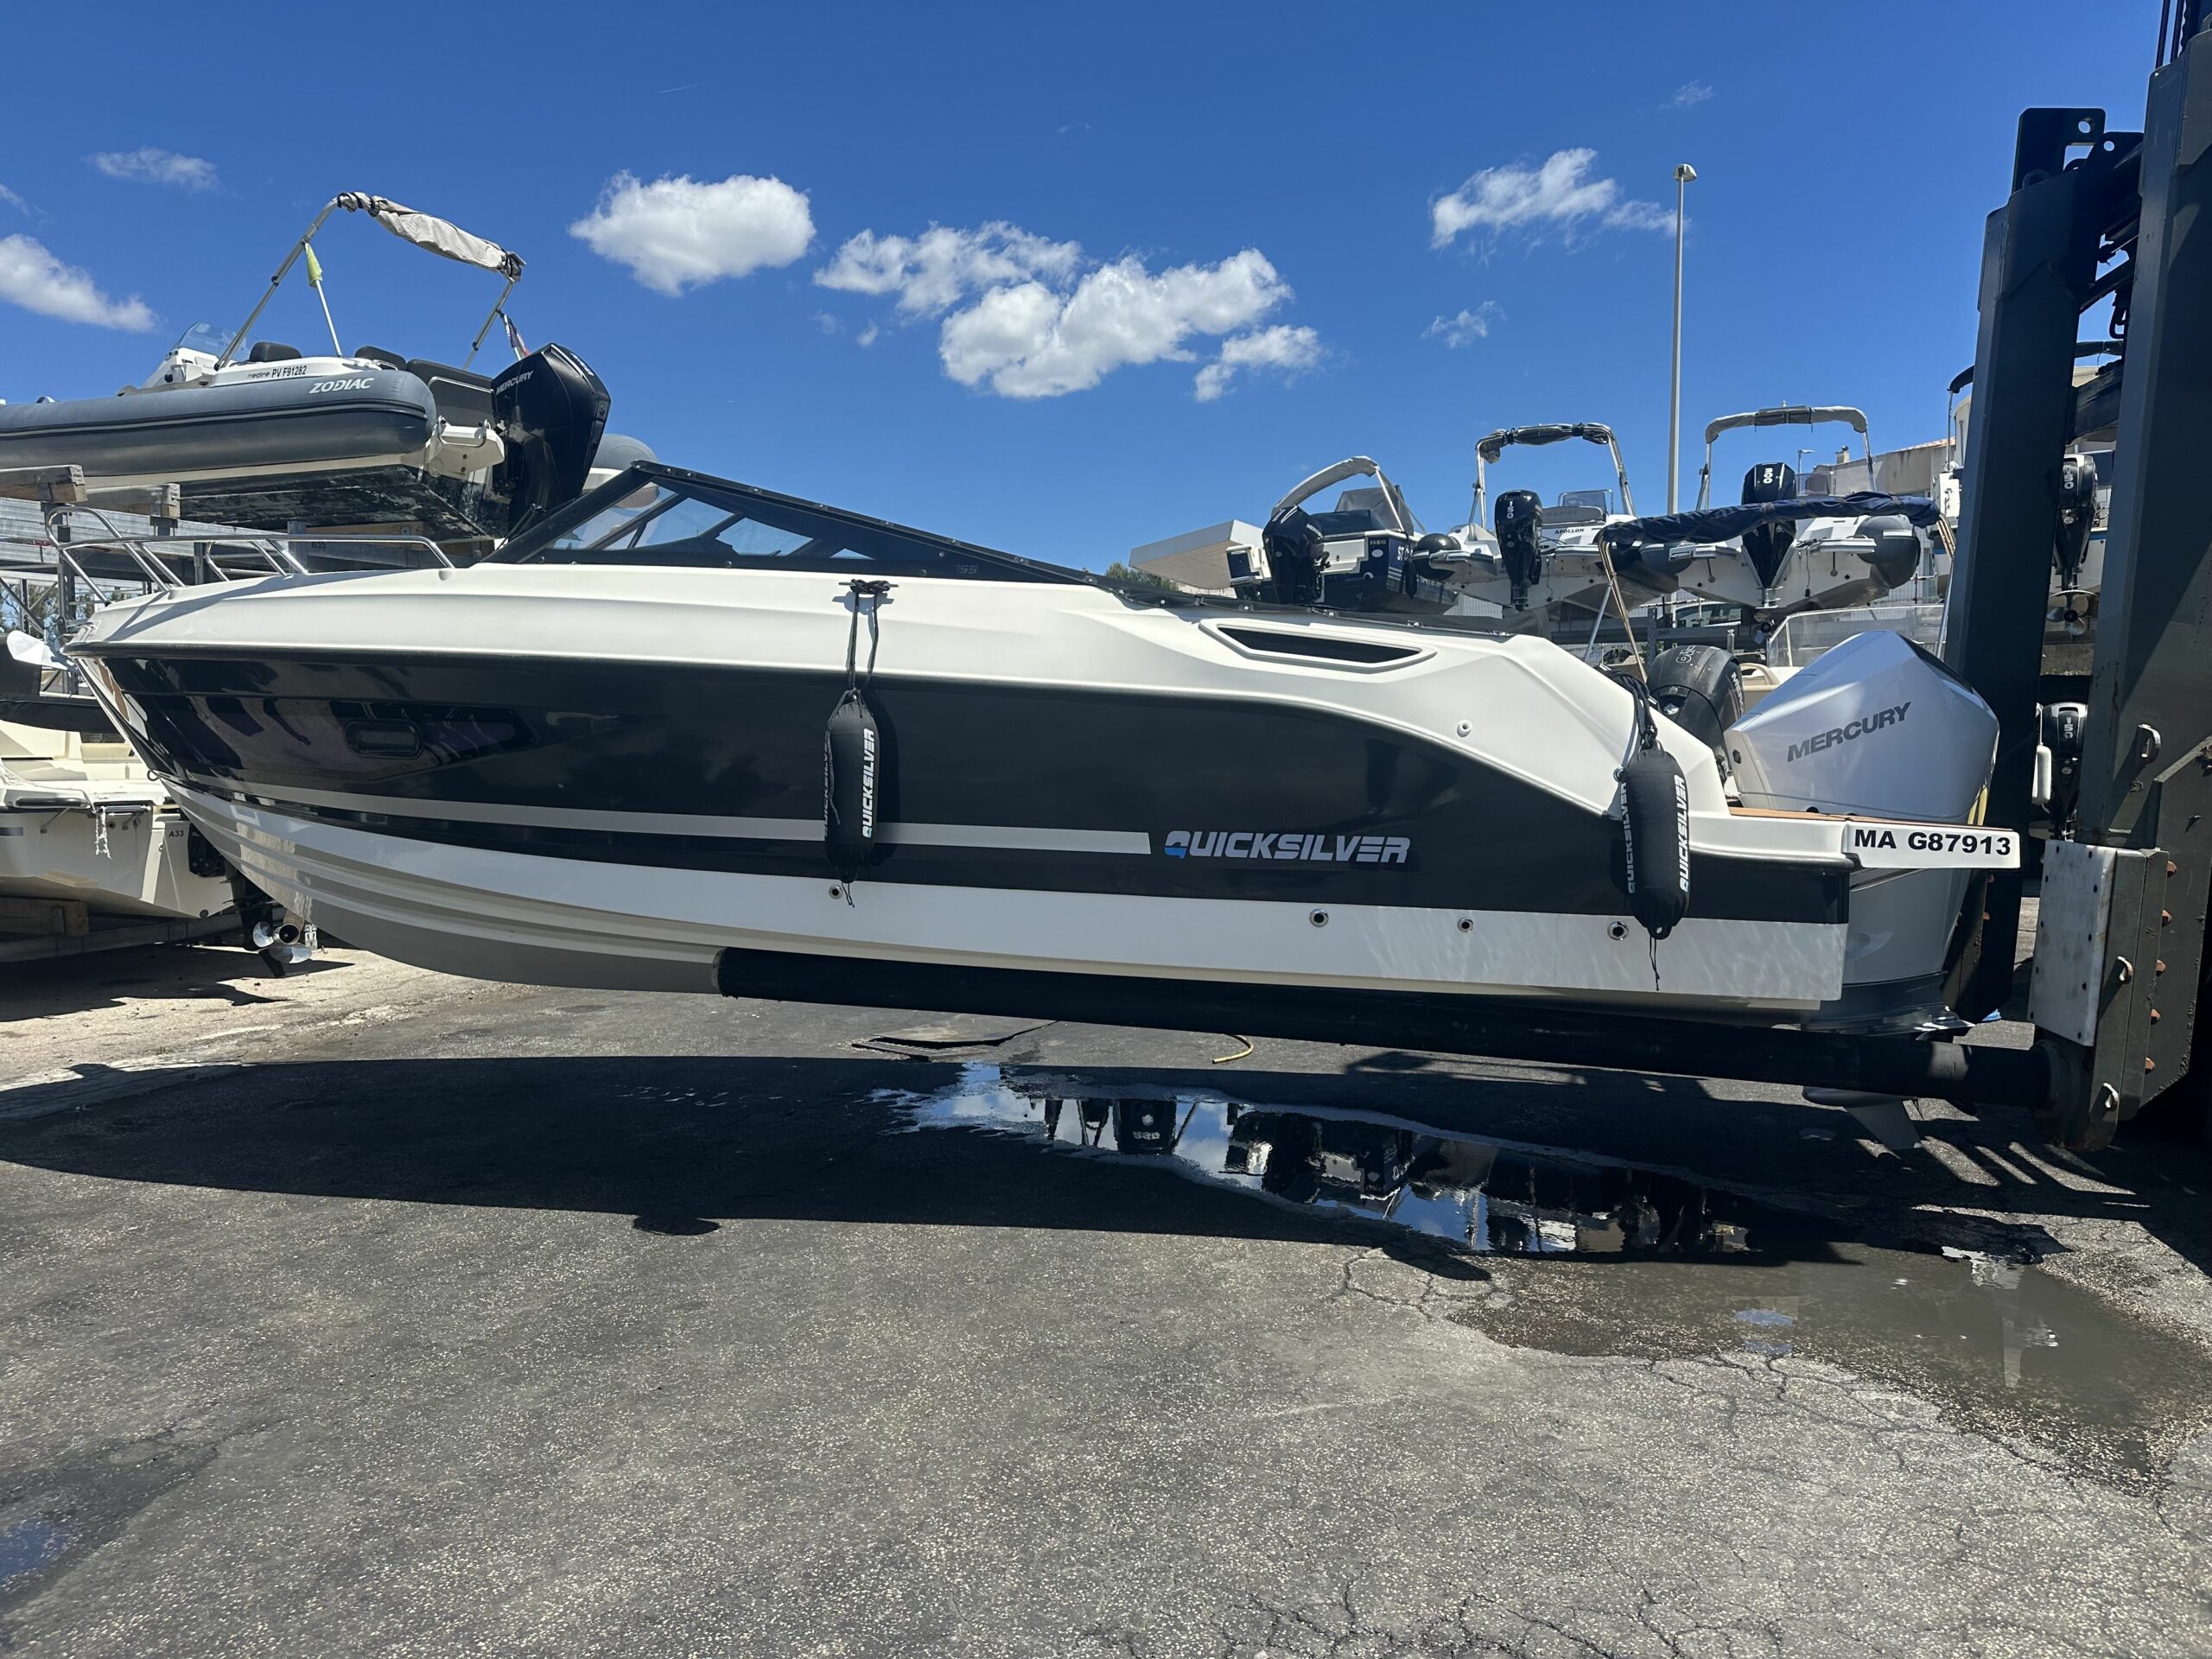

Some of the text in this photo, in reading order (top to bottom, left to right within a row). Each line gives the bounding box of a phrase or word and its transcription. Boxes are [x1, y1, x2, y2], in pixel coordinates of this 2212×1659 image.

[271, 368, 283, 378] PV
[283, 365, 308, 377] F91282
[495, 370, 534, 396] MERCURY
[308, 378, 375, 394] ZODIAC
[1506, 500, 1515, 519] 150
[1787, 702, 1911, 762] MERCURY
[862, 728, 875, 838] QUICKSILVER
[1164, 830, 1411, 863] QUICKSILVER
[1674, 774, 1689, 893] QUICKSILVER
[1854, 830, 2011, 855] MA G87913
